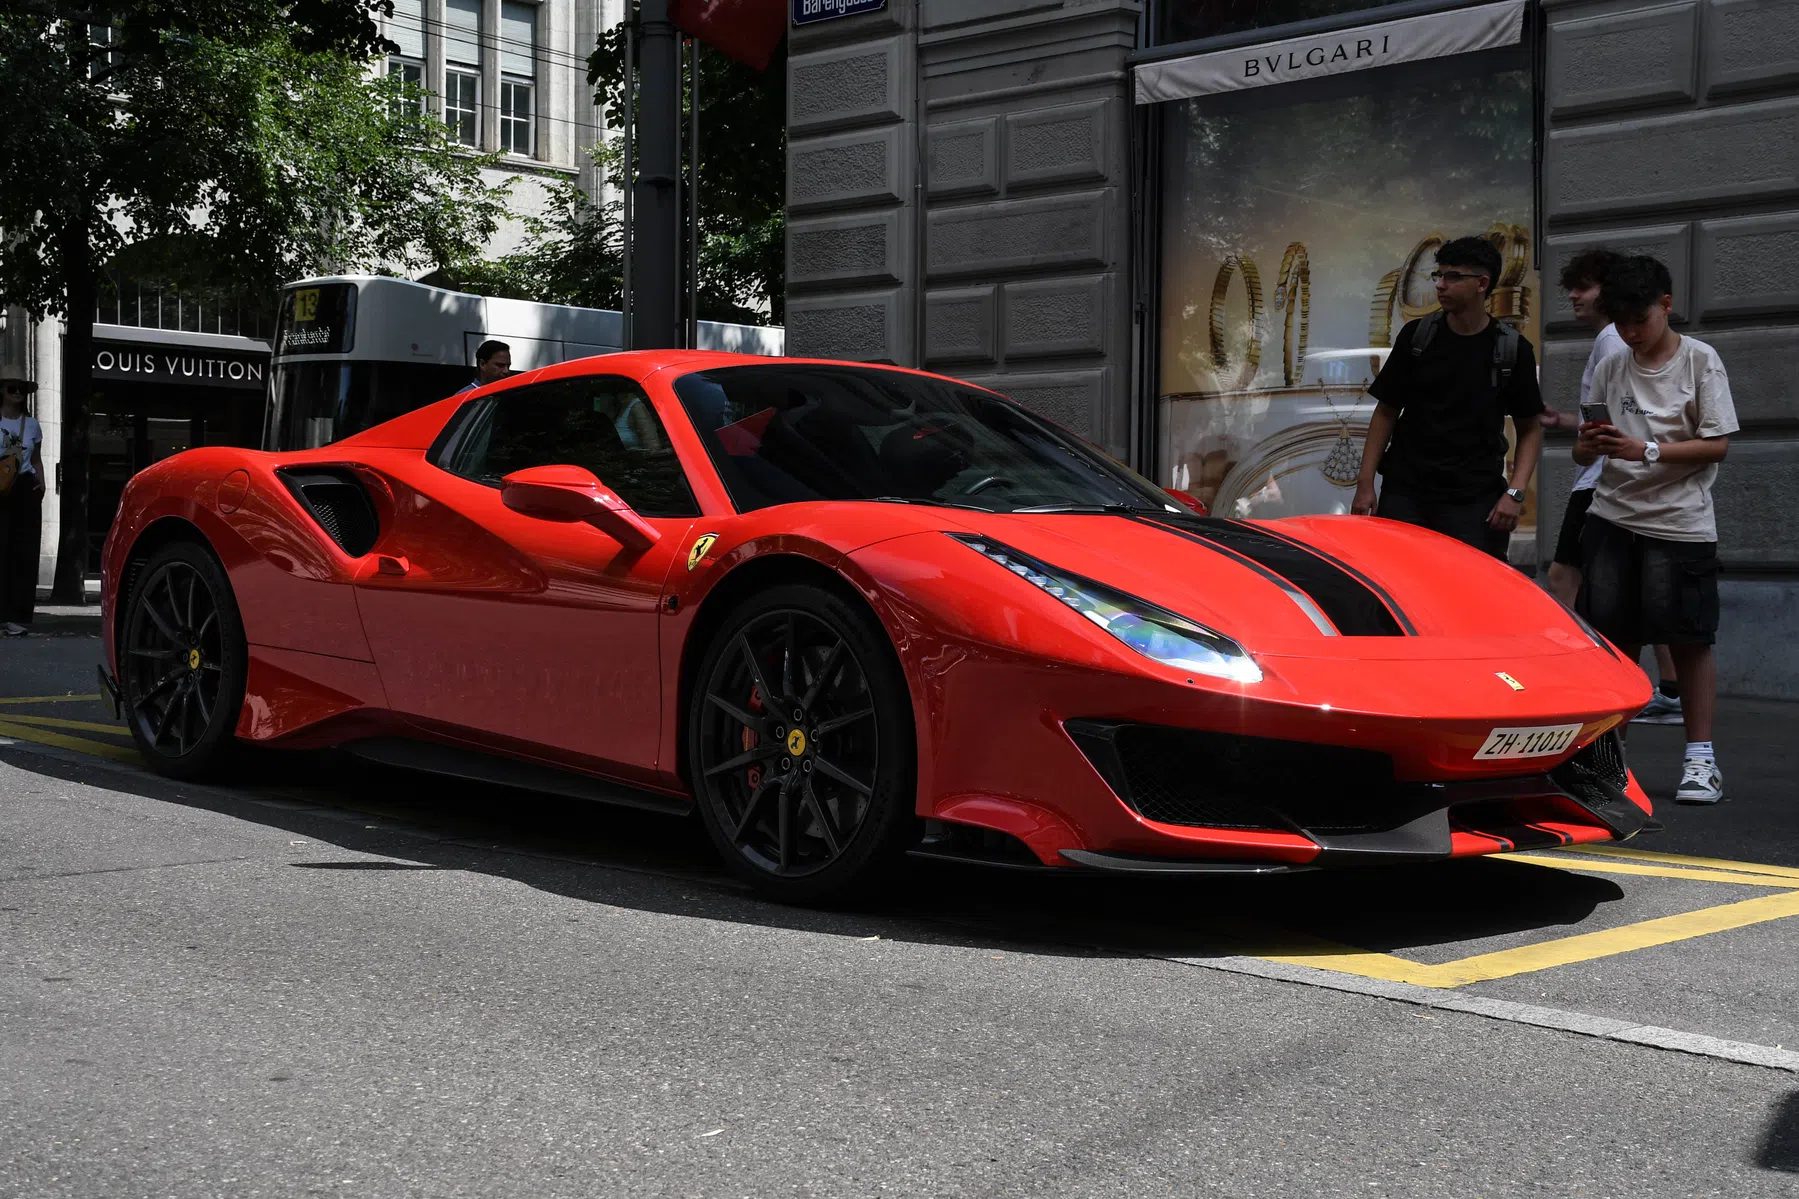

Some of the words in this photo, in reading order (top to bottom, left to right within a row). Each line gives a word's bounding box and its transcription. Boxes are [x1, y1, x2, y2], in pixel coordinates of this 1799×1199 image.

[1244, 35, 1389, 77] BVLGARI
[300, 293, 317, 317] 13
[92, 351, 155, 373] OUIS
[165, 356, 262, 381] VUITTON
